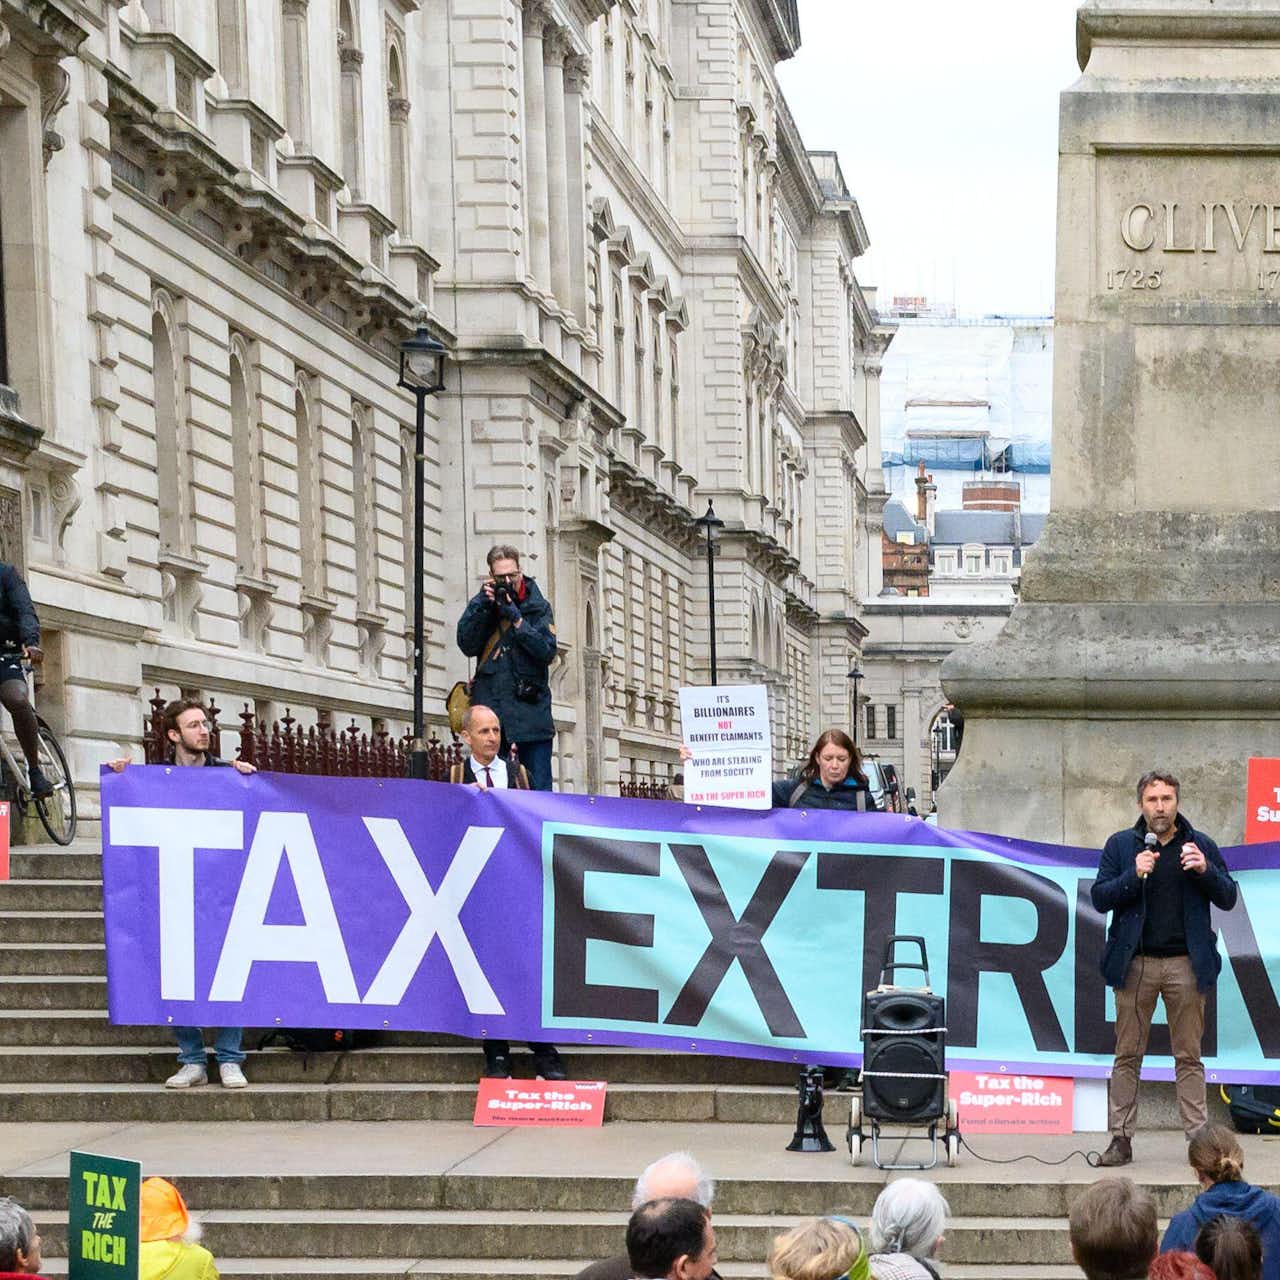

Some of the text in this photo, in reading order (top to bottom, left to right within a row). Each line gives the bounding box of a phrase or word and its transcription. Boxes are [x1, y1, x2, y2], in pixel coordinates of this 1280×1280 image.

[1106, 270, 1163, 290] 1725
[716, 696, 730, 704] IT'S
[694, 706, 755, 718] BILLIONAIRES
[718, 721, 732, 730] NOT
[690, 732, 763, 742] BENEFIT CLAIMANTS
[692, 756, 762, 767] WHO ARE STEALING
[701, 768, 754, 778] FROM SOCIETY
[691, 790, 766, 801] TAX THE SUPER RICH
[109, 806, 507, 1015] TAX
[975, 1075, 1044, 1090] Tax the
[505, 1090, 575, 1100] Tax the
[959, 1092, 1062, 1107] Super-Rich
[488, 1099, 592, 1111] Super-Rich
[82, 1171, 127, 1211] TAX
[92, 1212, 117, 1229] THE
[81, 1230, 126, 1266] RICH
